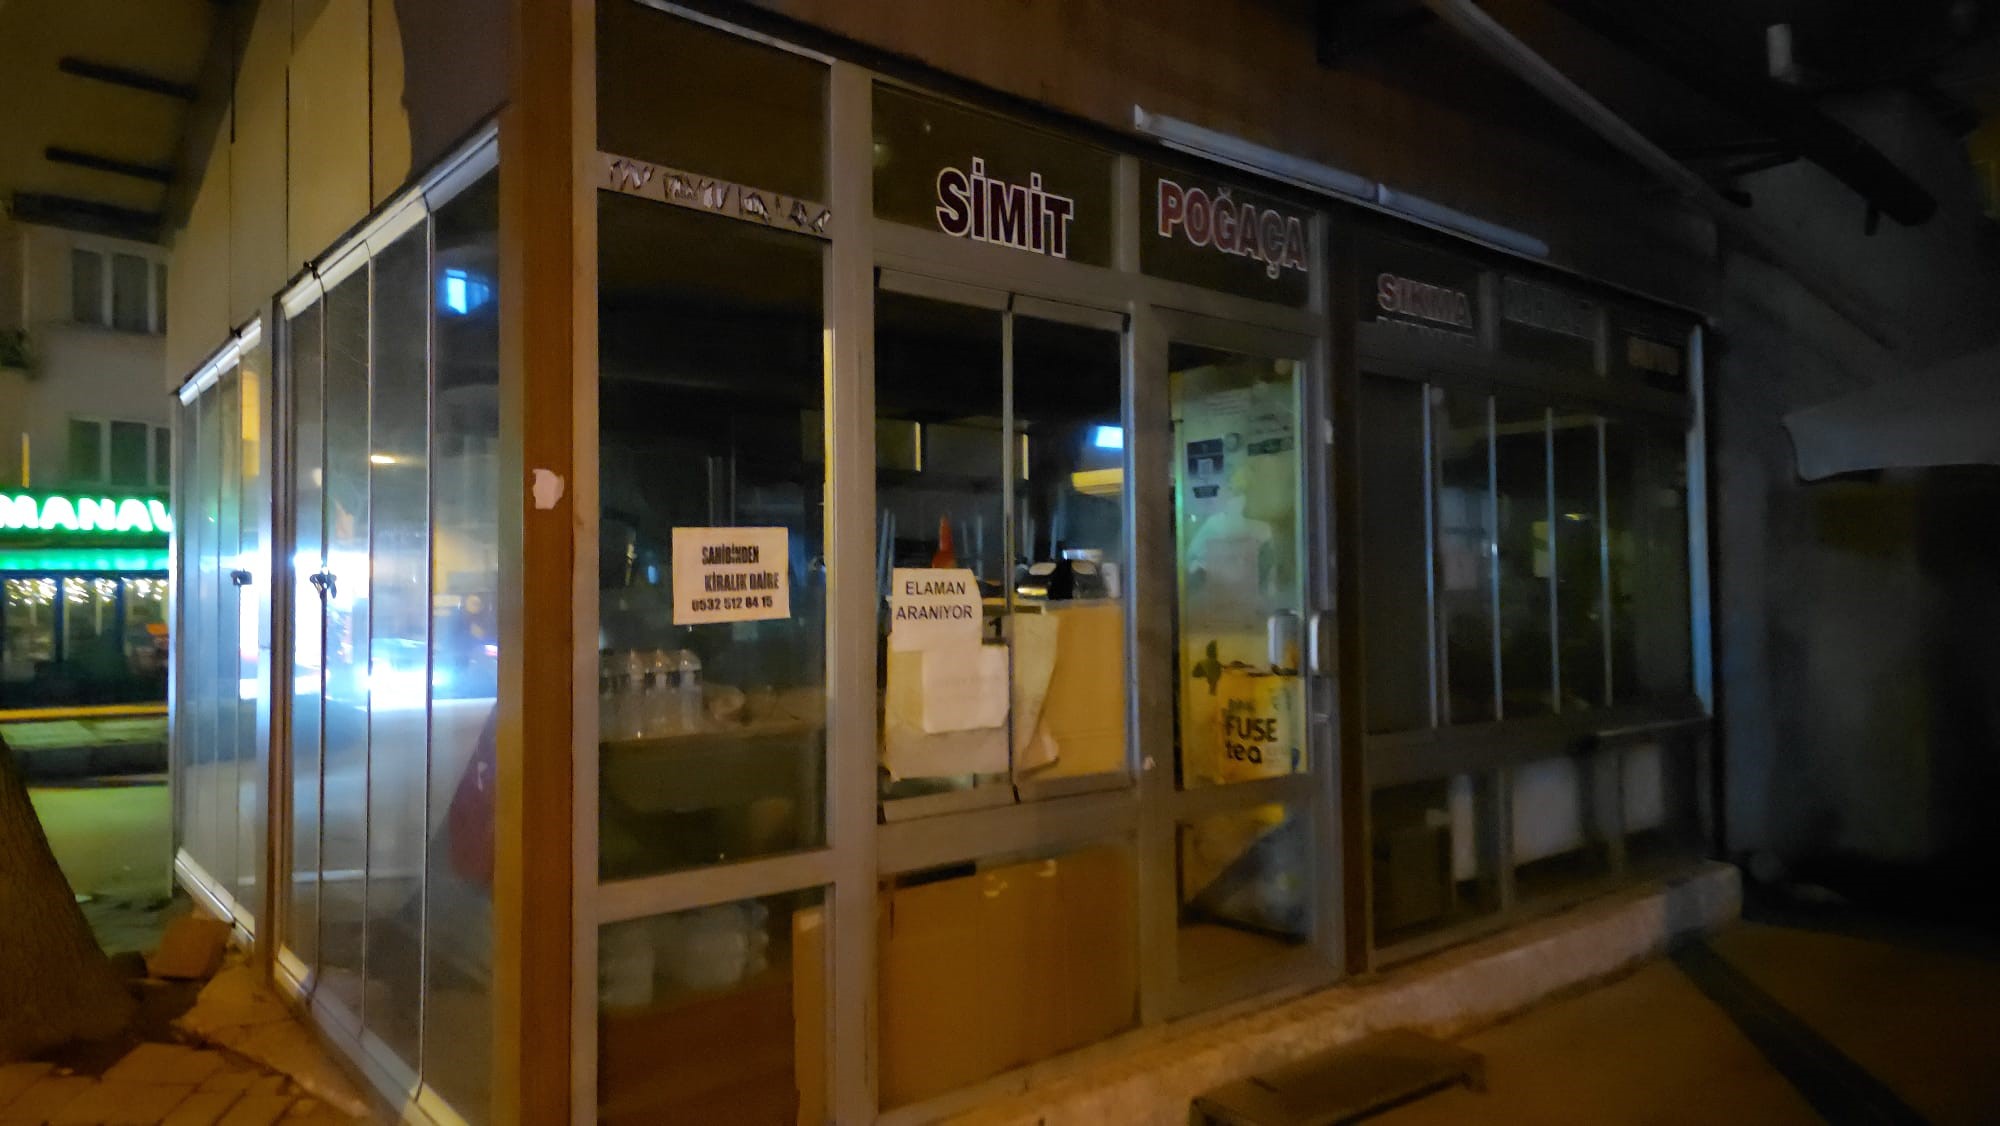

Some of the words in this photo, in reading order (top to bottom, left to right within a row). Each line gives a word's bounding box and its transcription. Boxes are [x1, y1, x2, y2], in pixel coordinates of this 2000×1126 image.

[936, 156, 1074, 259] SİMİT
[1158, 178, 1308, 279] POĞAÇA
[905, 580, 966, 596] ELAMAN
[895, 605, 973, 620] ARANIYOR
[1225, 716, 1277, 742] FUSE
[1225, 740, 1262, 764] tea
